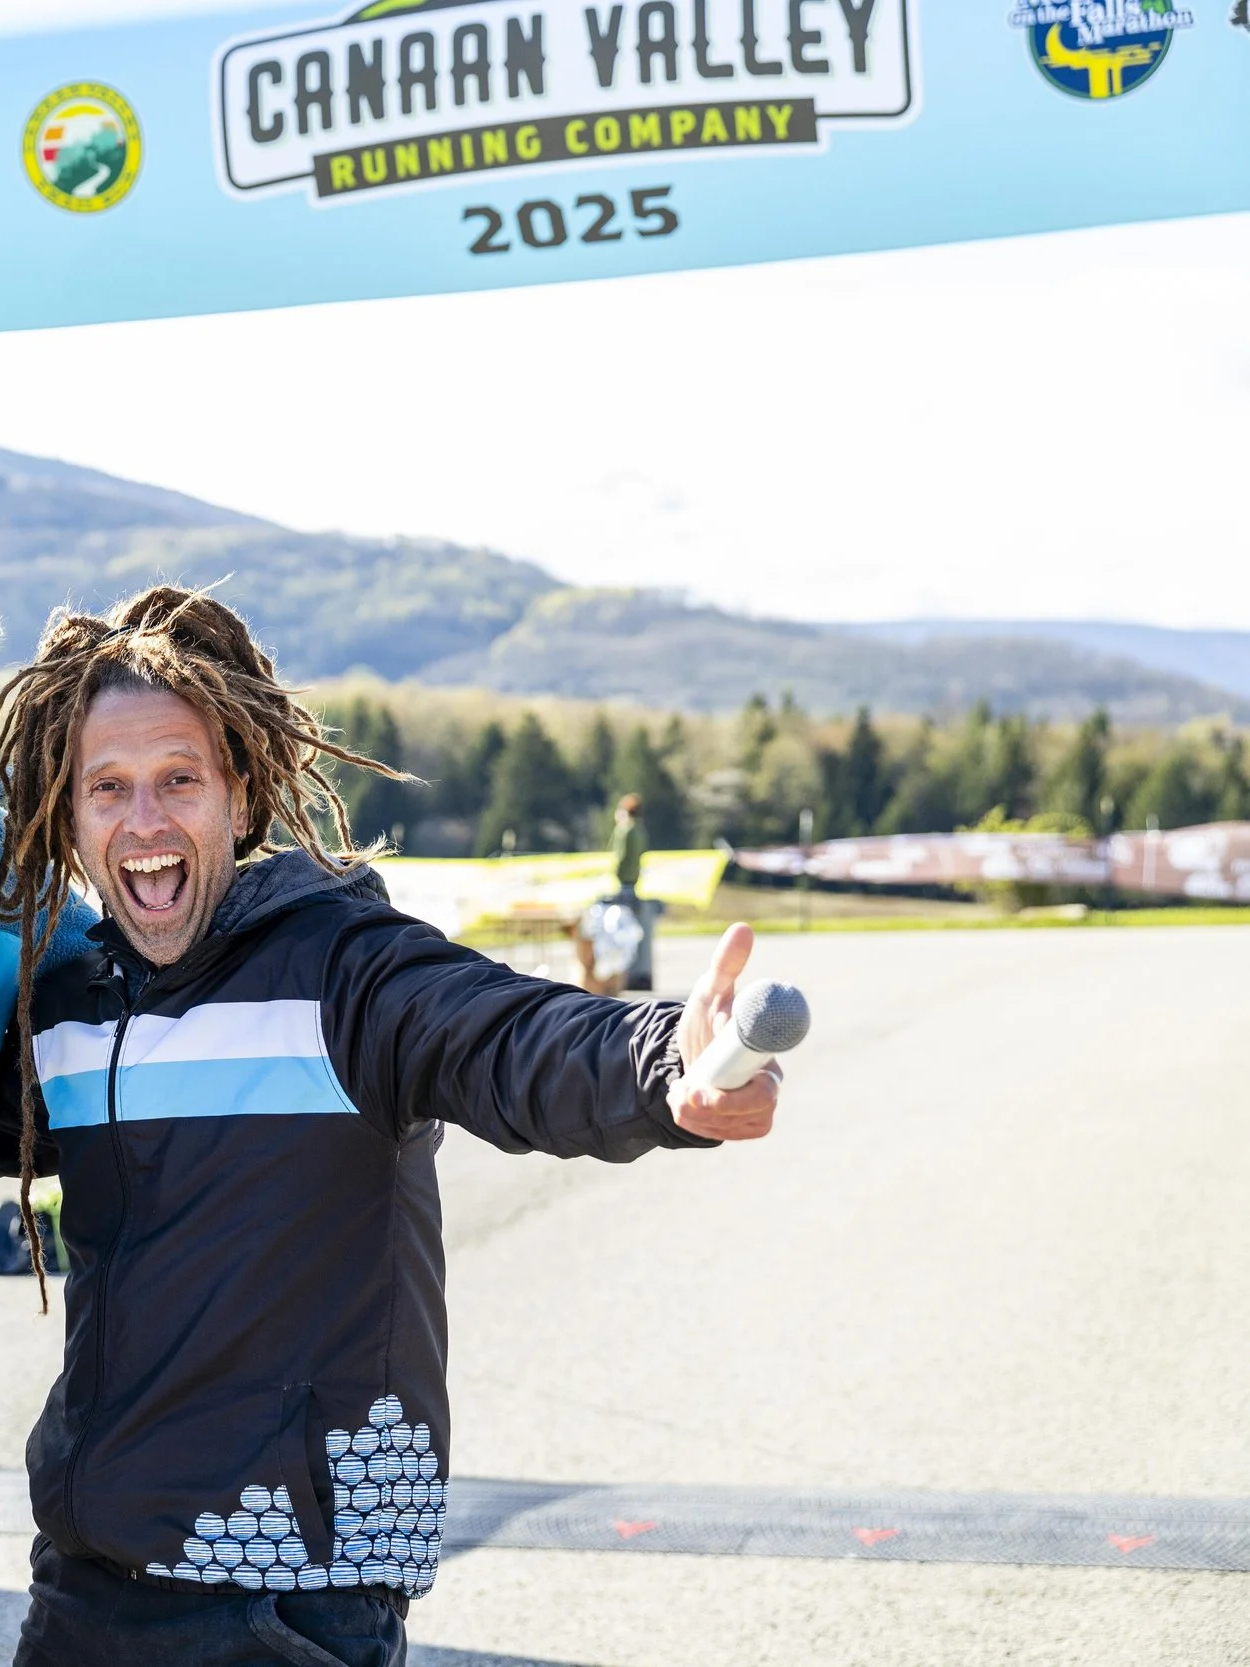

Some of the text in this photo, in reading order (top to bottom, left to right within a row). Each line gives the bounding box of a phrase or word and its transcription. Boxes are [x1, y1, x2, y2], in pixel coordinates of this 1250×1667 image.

[1078, 9, 1195, 45] Marathon
[248, 0, 882, 144] CANAAN VALLEY
[330, 104, 796, 191] RUNNING COMPANY
[463, 186, 680, 255] 2025
